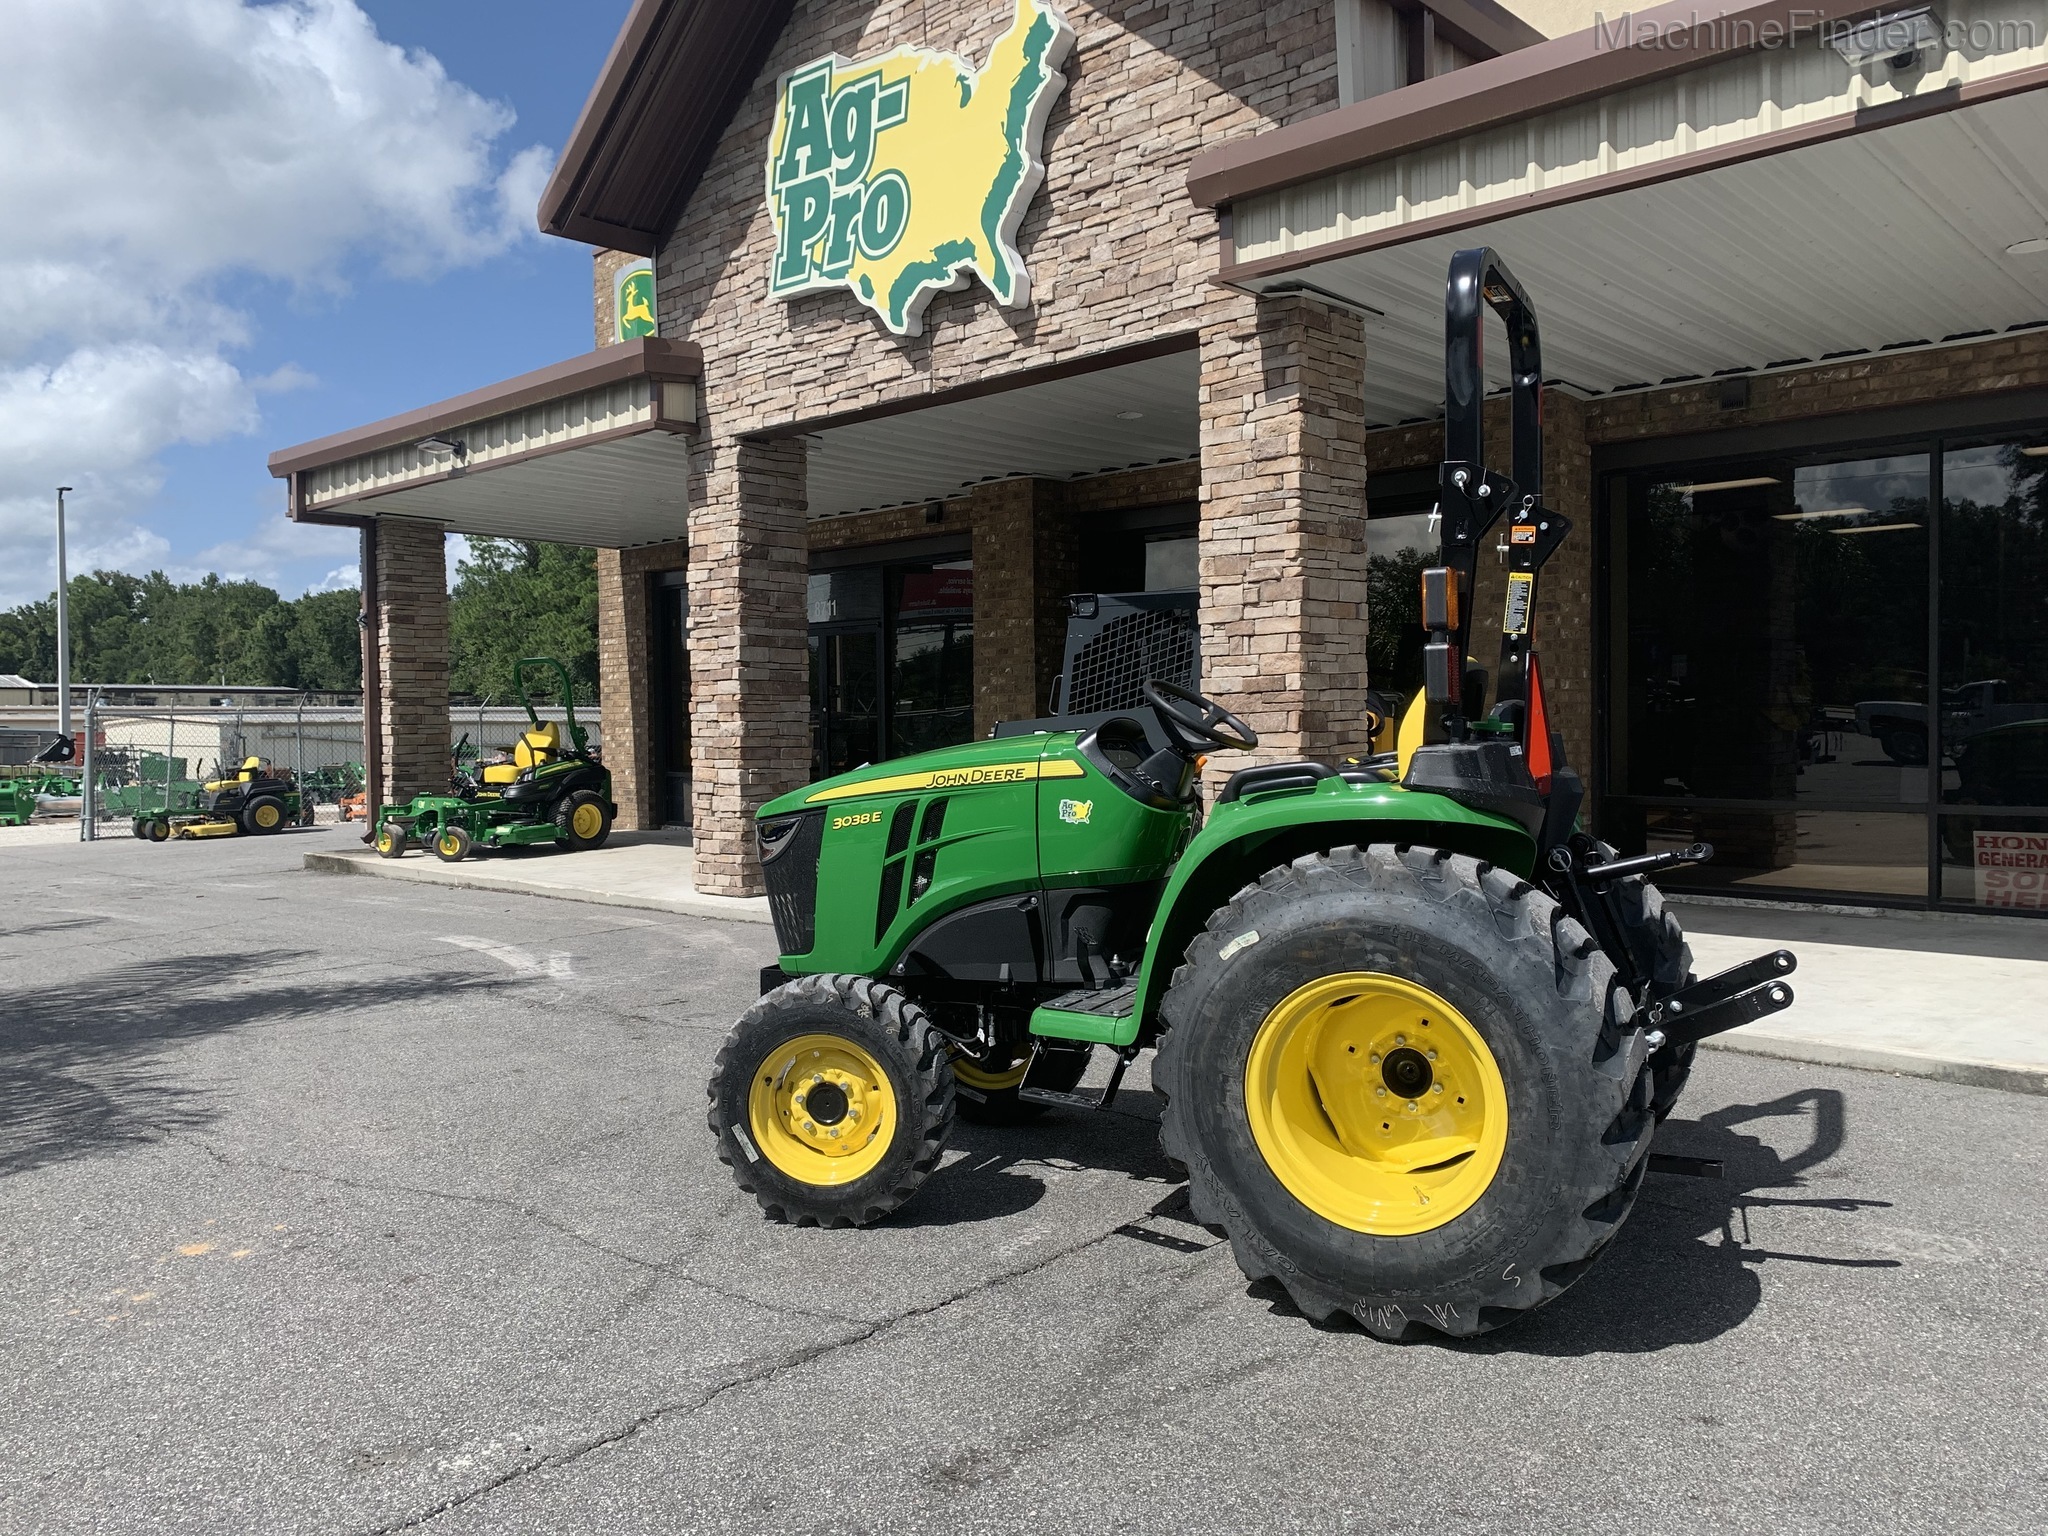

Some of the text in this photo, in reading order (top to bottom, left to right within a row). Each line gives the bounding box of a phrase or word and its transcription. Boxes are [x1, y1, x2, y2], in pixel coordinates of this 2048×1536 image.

[773, 62, 909, 193] Ag-
[772, 172, 910, 289] Pro
[814, 600, 837, 617] 8711
[926, 768, 1026, 787] JOHN DEERE
[1061, 809, 1077, 818] Pro
[1195, 1152, 1297, 1273] GALAXY
